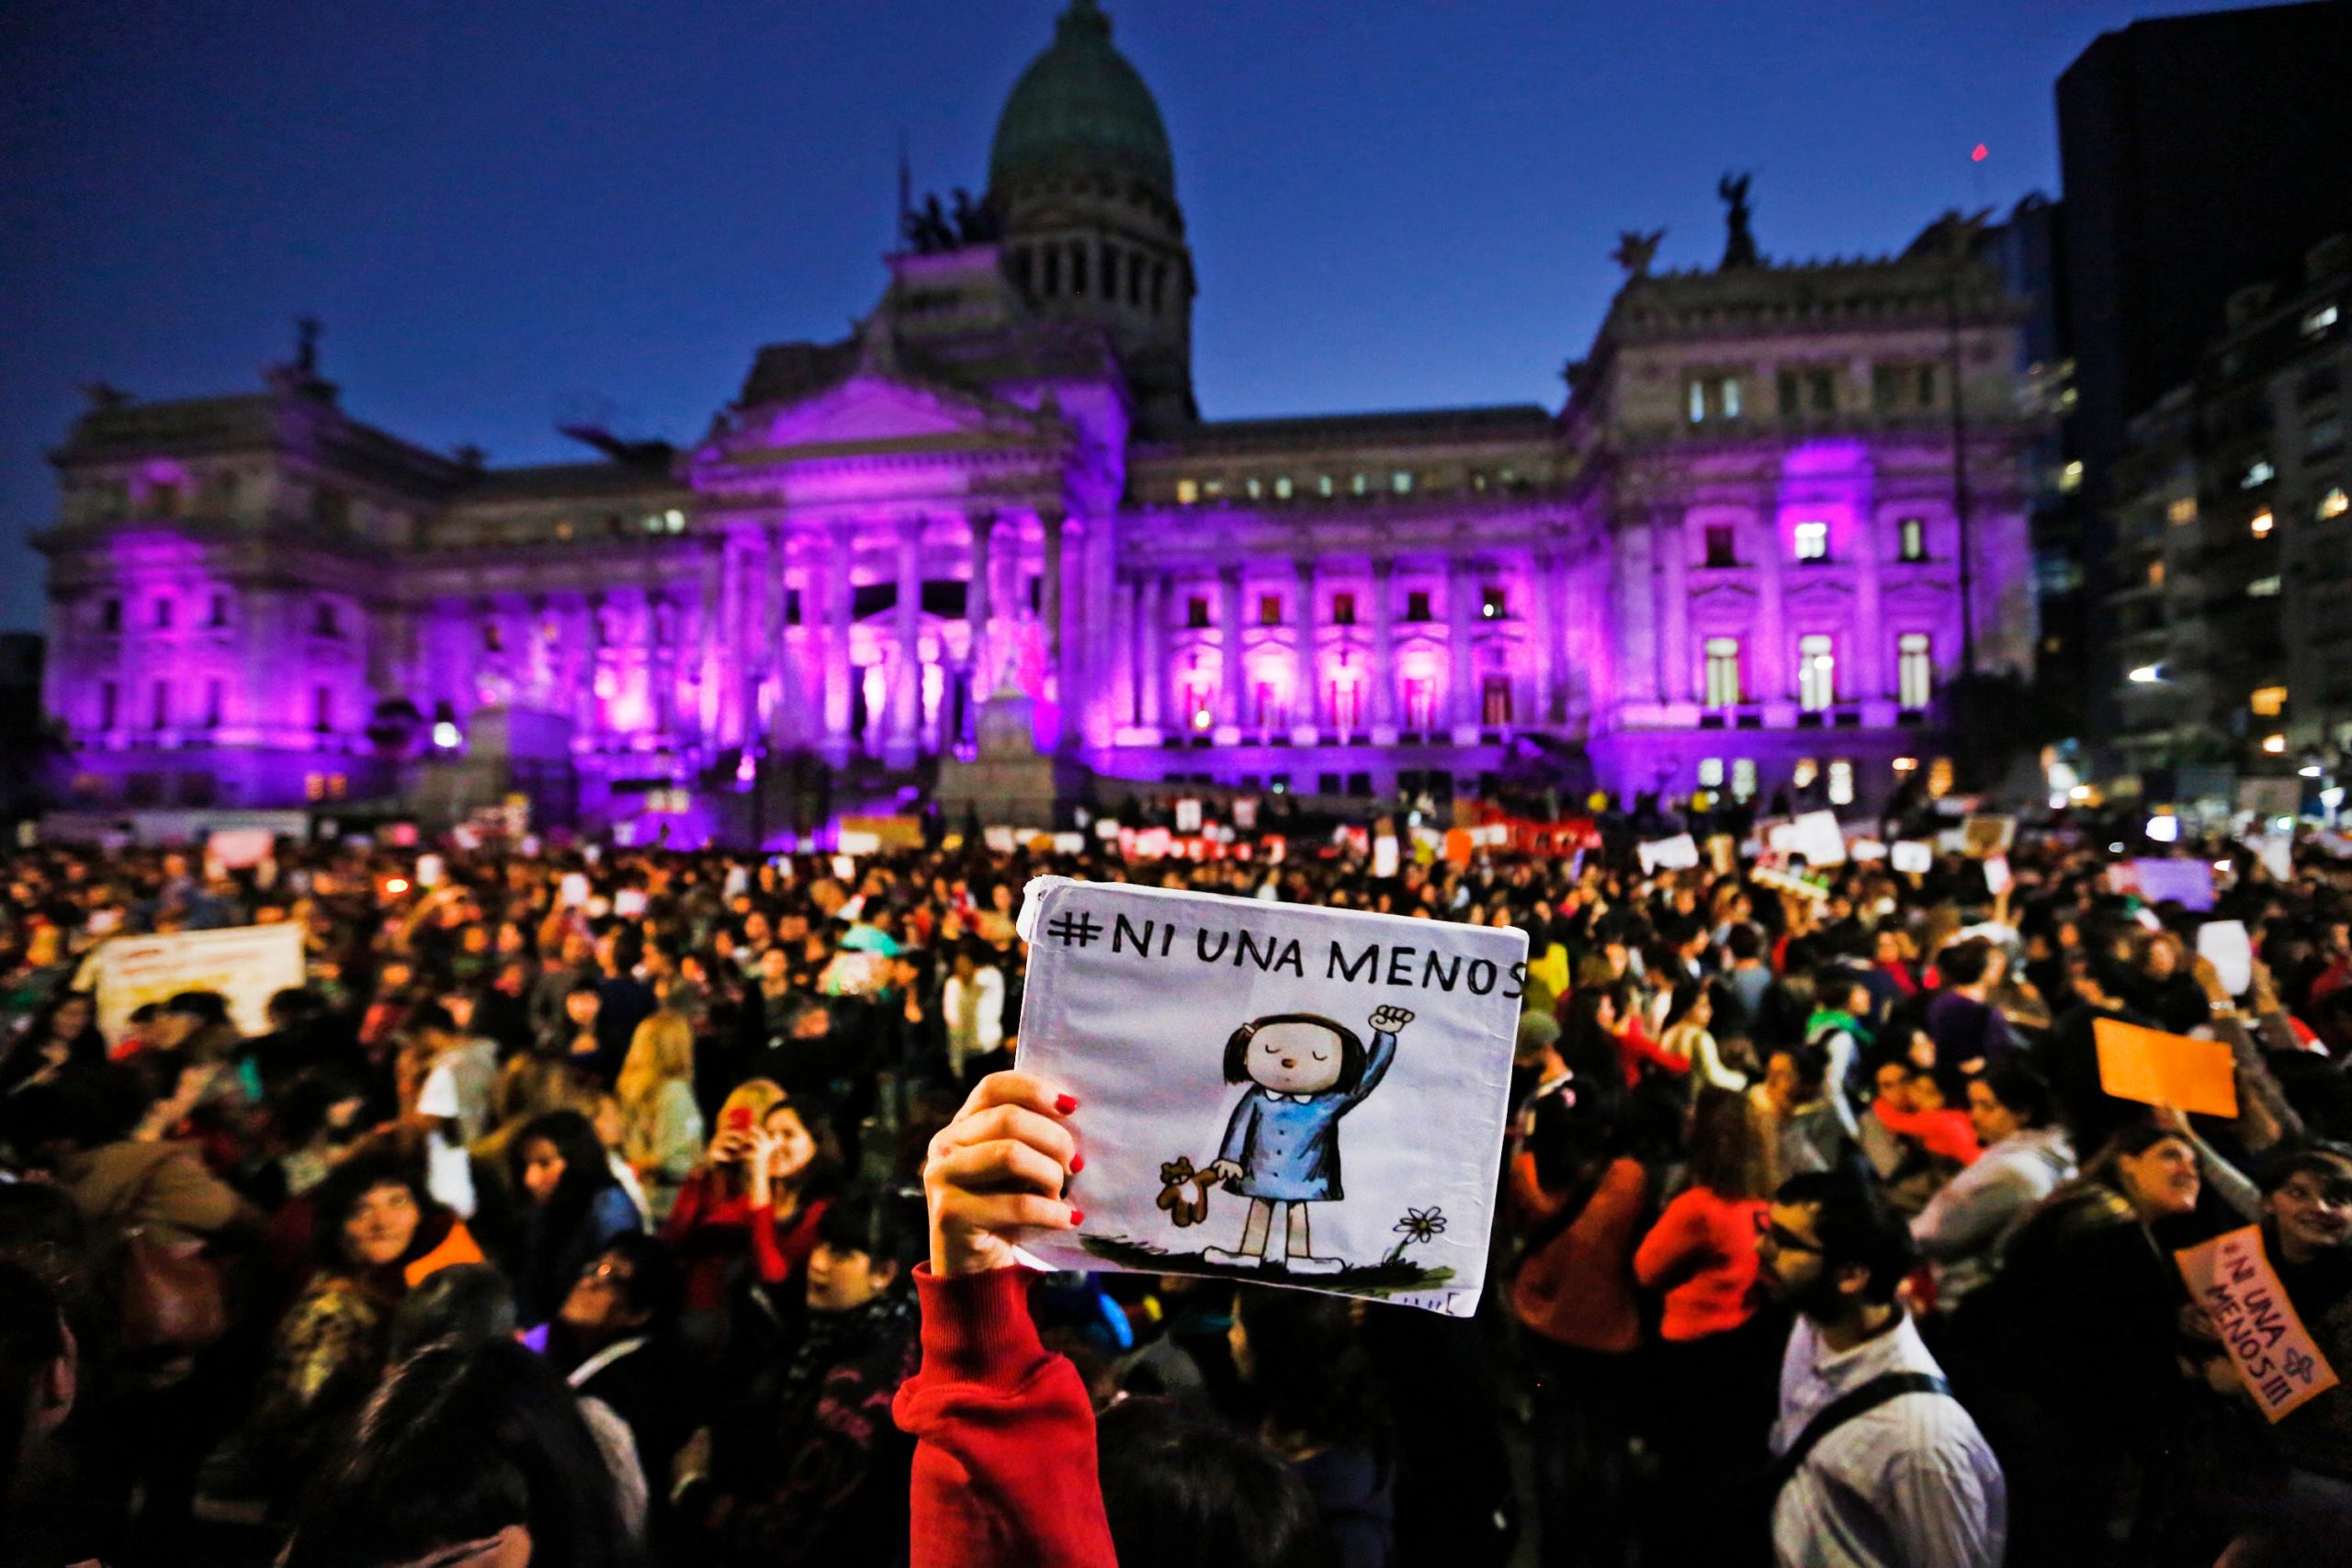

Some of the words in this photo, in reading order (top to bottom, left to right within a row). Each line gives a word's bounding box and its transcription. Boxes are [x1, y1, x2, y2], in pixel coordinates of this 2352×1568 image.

[1046, 910, 1175, 958] #NI
[1196, 927, 1304, 977] UNA
[1327, 940, 1528, 998] MENOS
[2243, 1288, 2288, 1348] UNA
